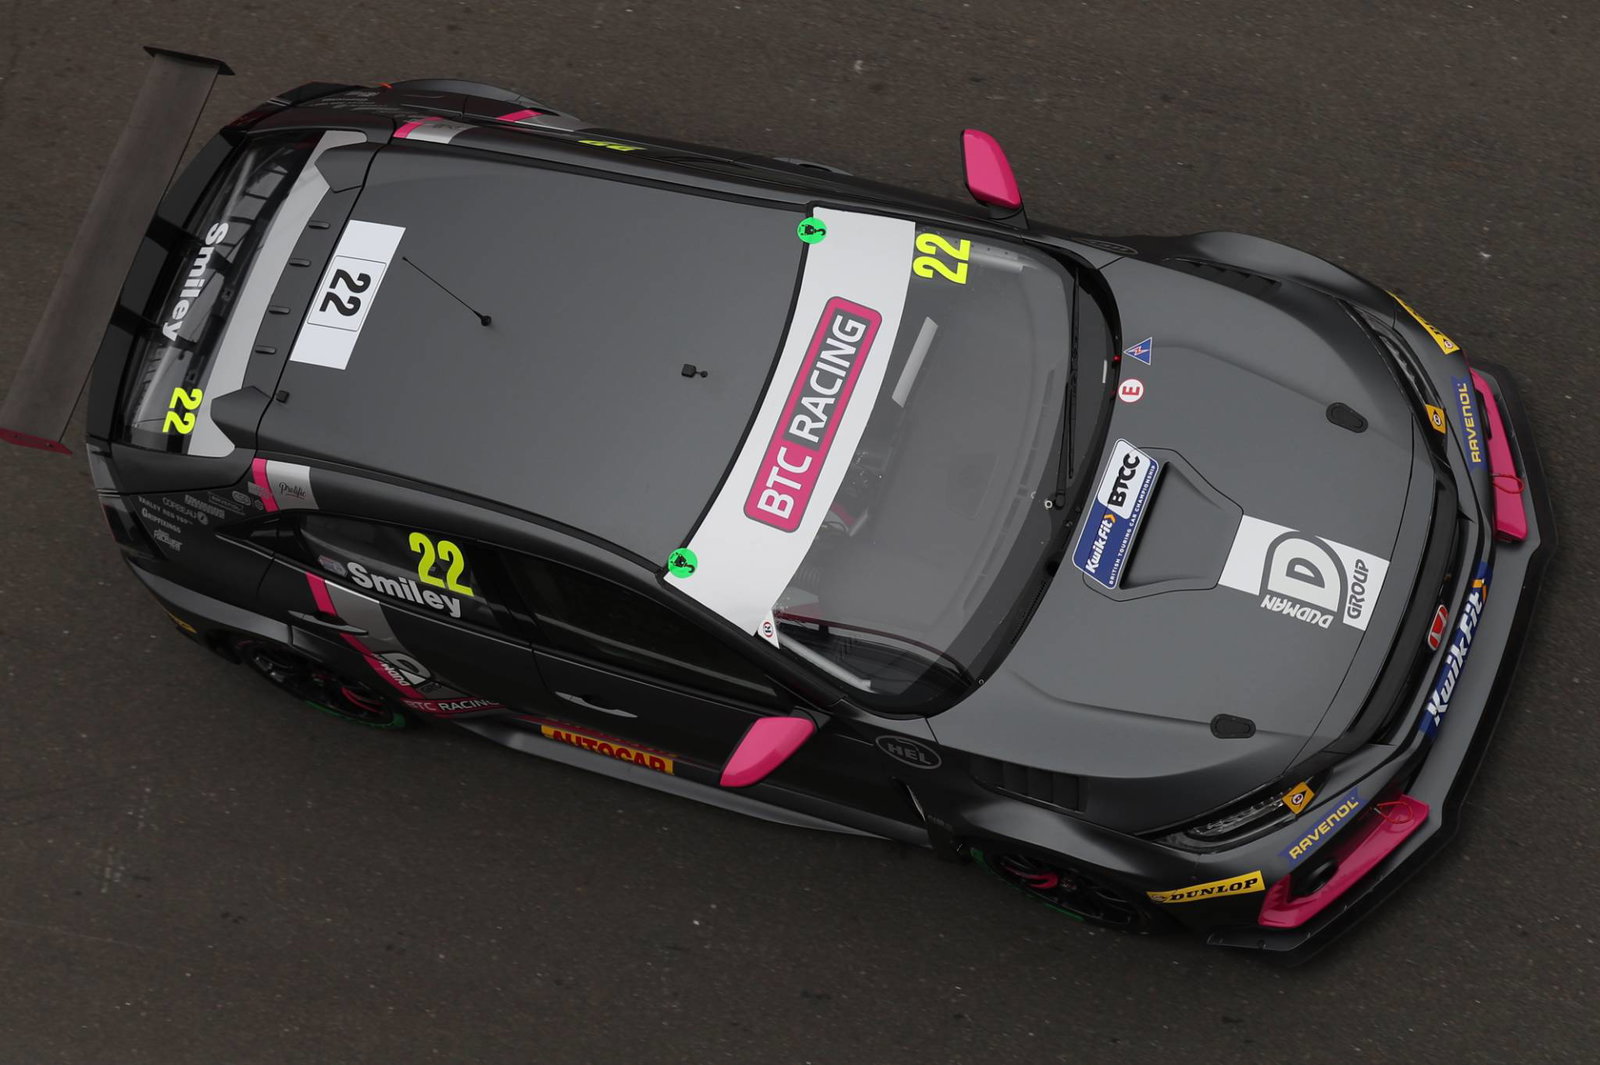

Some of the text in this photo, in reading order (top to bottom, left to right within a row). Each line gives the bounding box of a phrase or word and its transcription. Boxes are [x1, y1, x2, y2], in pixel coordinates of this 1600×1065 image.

[162, 222, 229, 342] Smiley
[913, 232, 971, 285] 22
[319, 268, 372, 317] 22
[162, 387, 203, 435] 22
[757, 313, 868, 520] BTC RACING
[1121, 385, 1141, 396] E
[1459, 382, 1482, 463] RAVENOL
[1107, 452, 1141, 508] BTCC
[1108, 558, 1121, 585] BRITISH
[1118, 528, 1132, 558] TOURING
[1134, 465, 1156, 513] CHAMPIONSHIP
[346, 561, 462, 619] Smiley
[408, 532, 475, 597] 22
[1346, 558, 1370, 620] GROUP
[1261, 593, 1335, 630] DUDMAN
[887, 742, 933, 766] HEL
[1288, 796, 1359, 861] RAVENOL
[1170, 877, 1259, 901] DUNLOP
